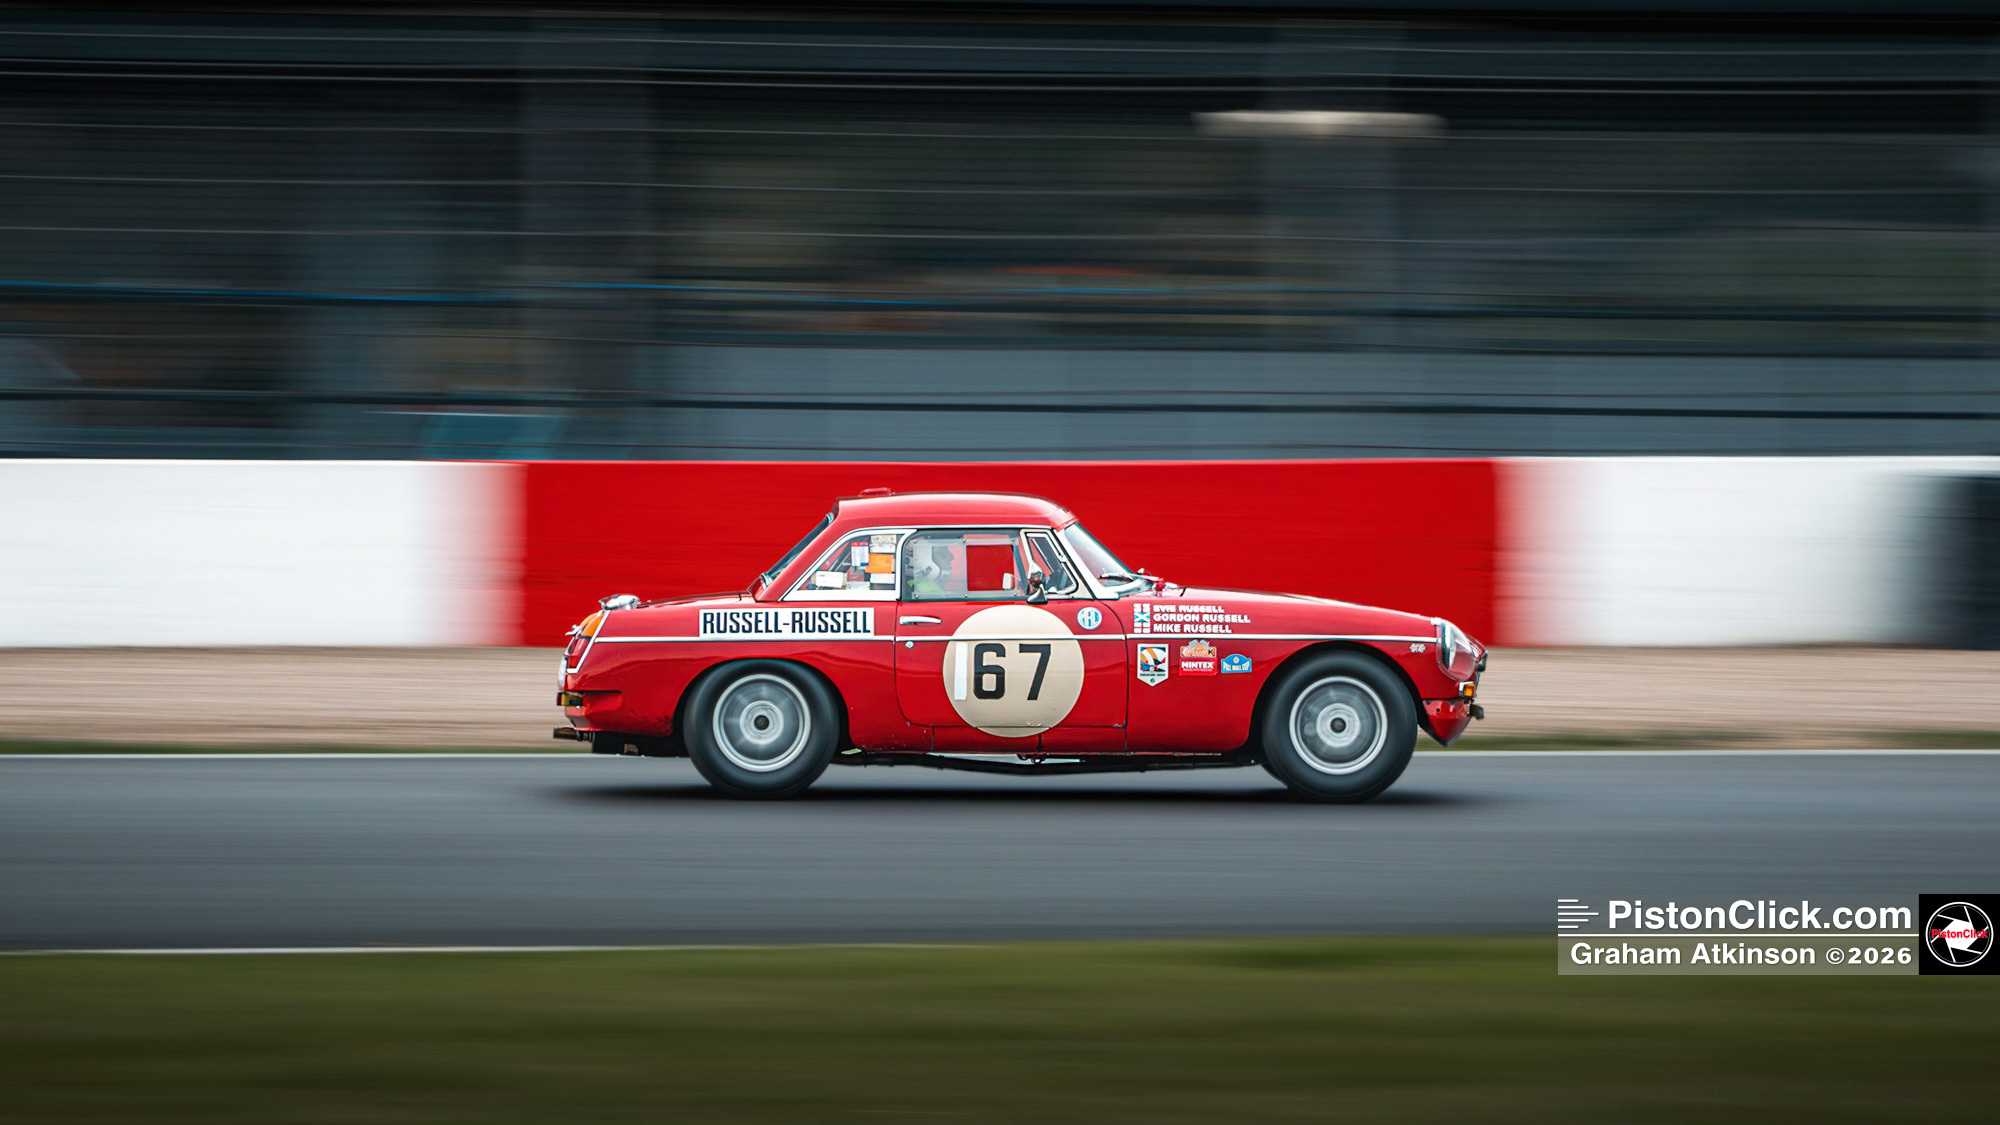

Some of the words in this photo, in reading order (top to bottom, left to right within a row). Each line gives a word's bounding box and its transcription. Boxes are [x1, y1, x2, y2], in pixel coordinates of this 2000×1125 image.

[1178, 605, 1225, 613] RUSSELL
[703, 611, 871, 634] RUSSELL-RUSSELL
[1153, 613, 1200, 622] GORDON
[1202, 614, 1251, 623] RUSSELL
[1153, 624, 1181, 633] MIKE
[1183, 624, 1232, 633] RUSSELL
[1181, 661, 1214, 669] MINTEX
